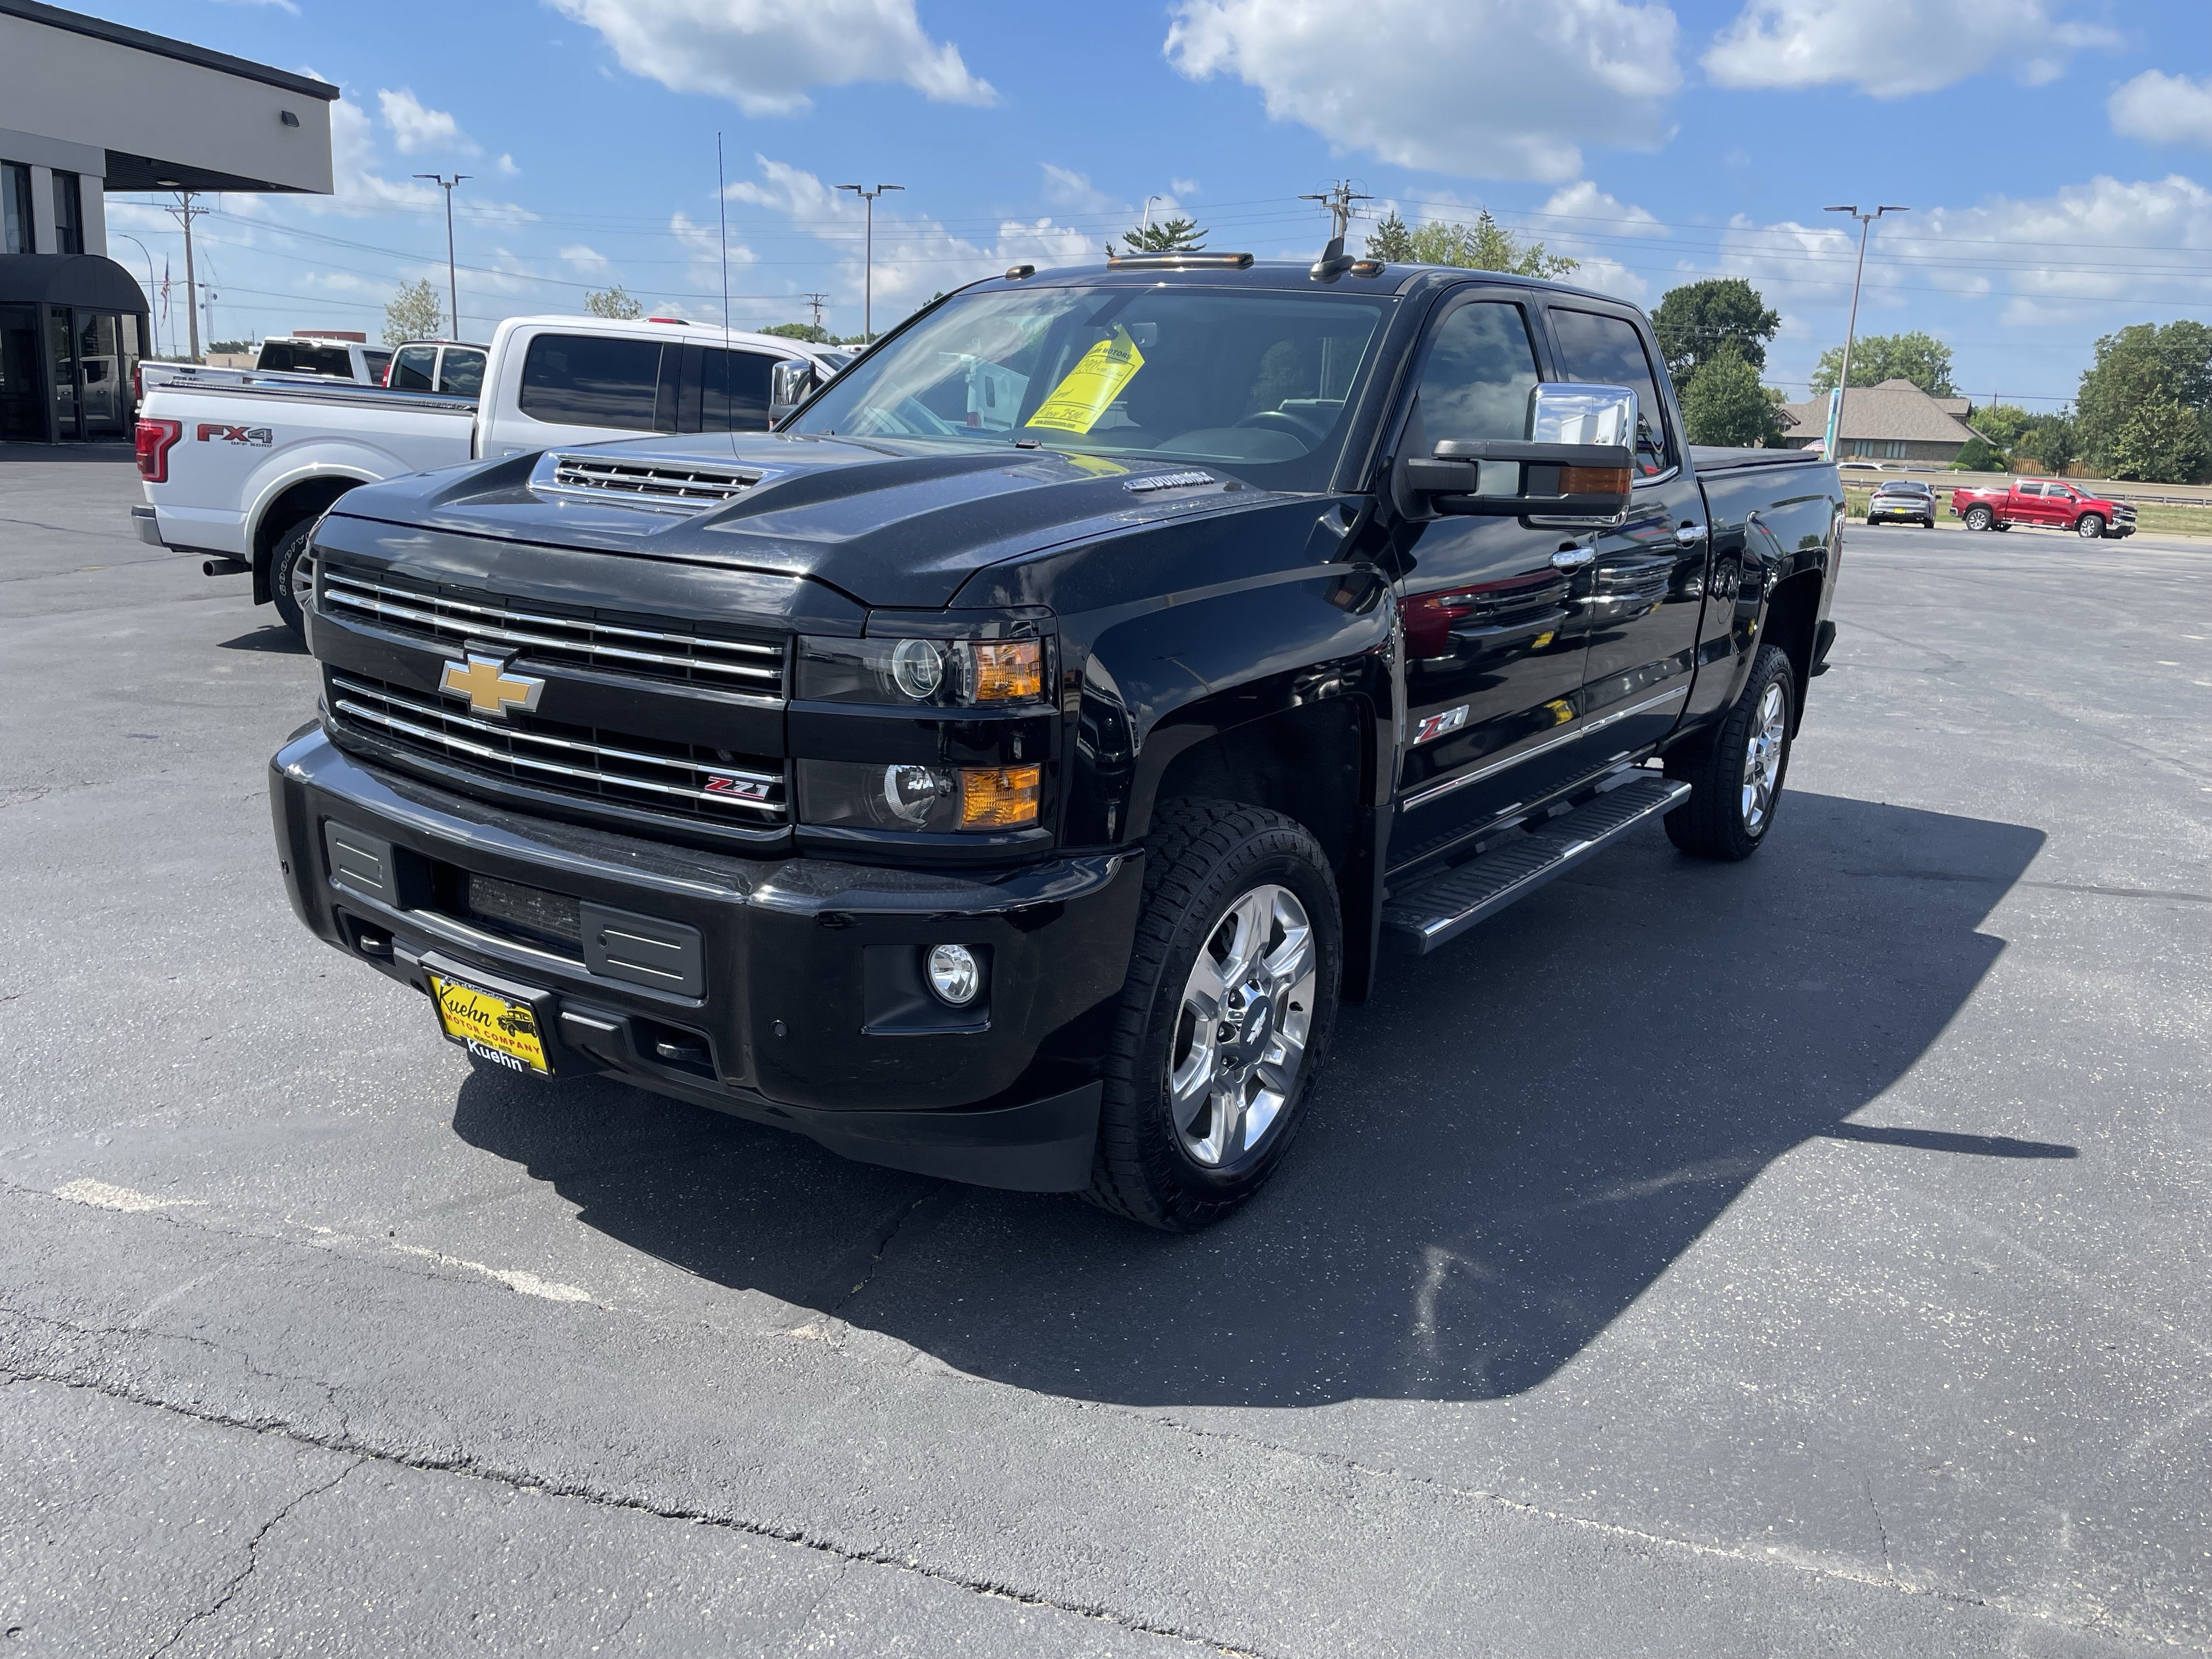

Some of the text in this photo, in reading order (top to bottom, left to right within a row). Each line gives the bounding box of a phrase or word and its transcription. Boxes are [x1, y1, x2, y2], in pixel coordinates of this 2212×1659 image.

[1102, 347, 1133, 360] MOTORS
[1060, 408, 1085, 420] 2500
[197, 424, 273, 444] FX4
[1146, 471, 1215, 488] DURAMAX
[1413, 704, 1470, 745] Z71
[704, 776, 770, 800] Z71
[439, 985, 492, 1028] Kuehn
[445, 1013, 540, 1054] MOTOR COMPANY
[466, 1037, 523, 1073] Kuehn
